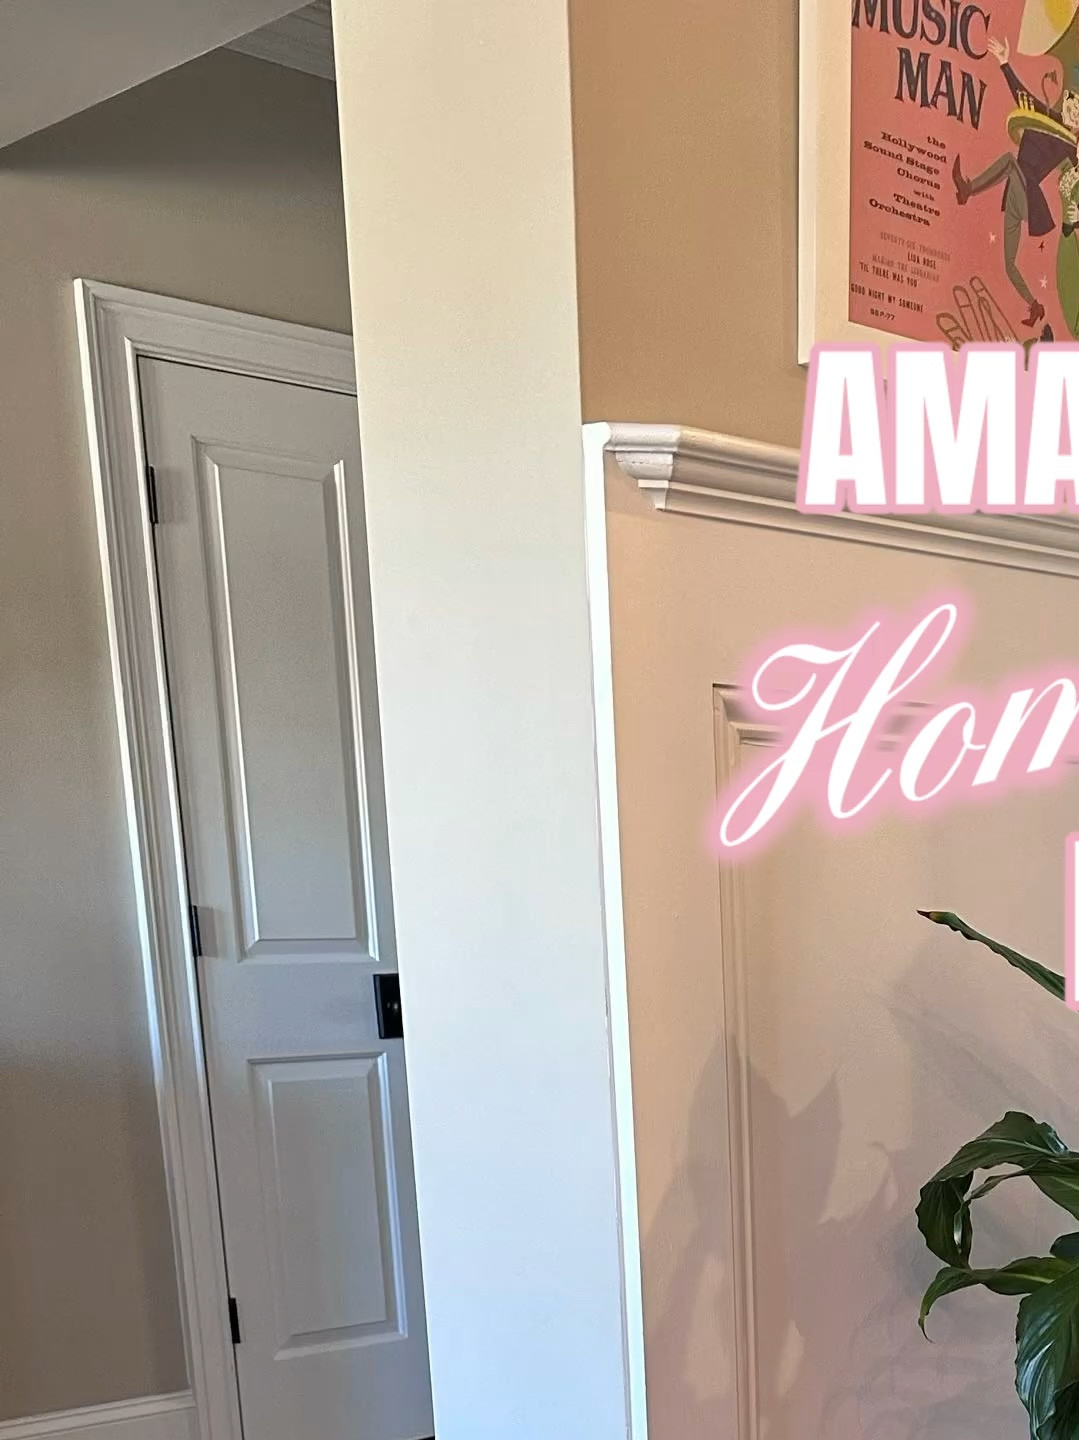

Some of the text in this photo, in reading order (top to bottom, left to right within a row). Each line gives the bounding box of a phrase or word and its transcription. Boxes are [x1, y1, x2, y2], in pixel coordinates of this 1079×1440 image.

[851, 0, 990, 60] MUSIC
[895, 47, 987, 130] MAN
[881, 131, 947, 163] Hollywood
[927, 136, 946, 149] the
[864, 140, 940, 175] Sound Stage
[897, 167, 941, 190] Chorus
[894, 193, 941, 217] Theatre
[913, 190, 935, 201] with
[869, 198, 930, 226] Orchestra
[892, 273, 904, 284] WAS
[868, 288, 885, 301] NIGHT
